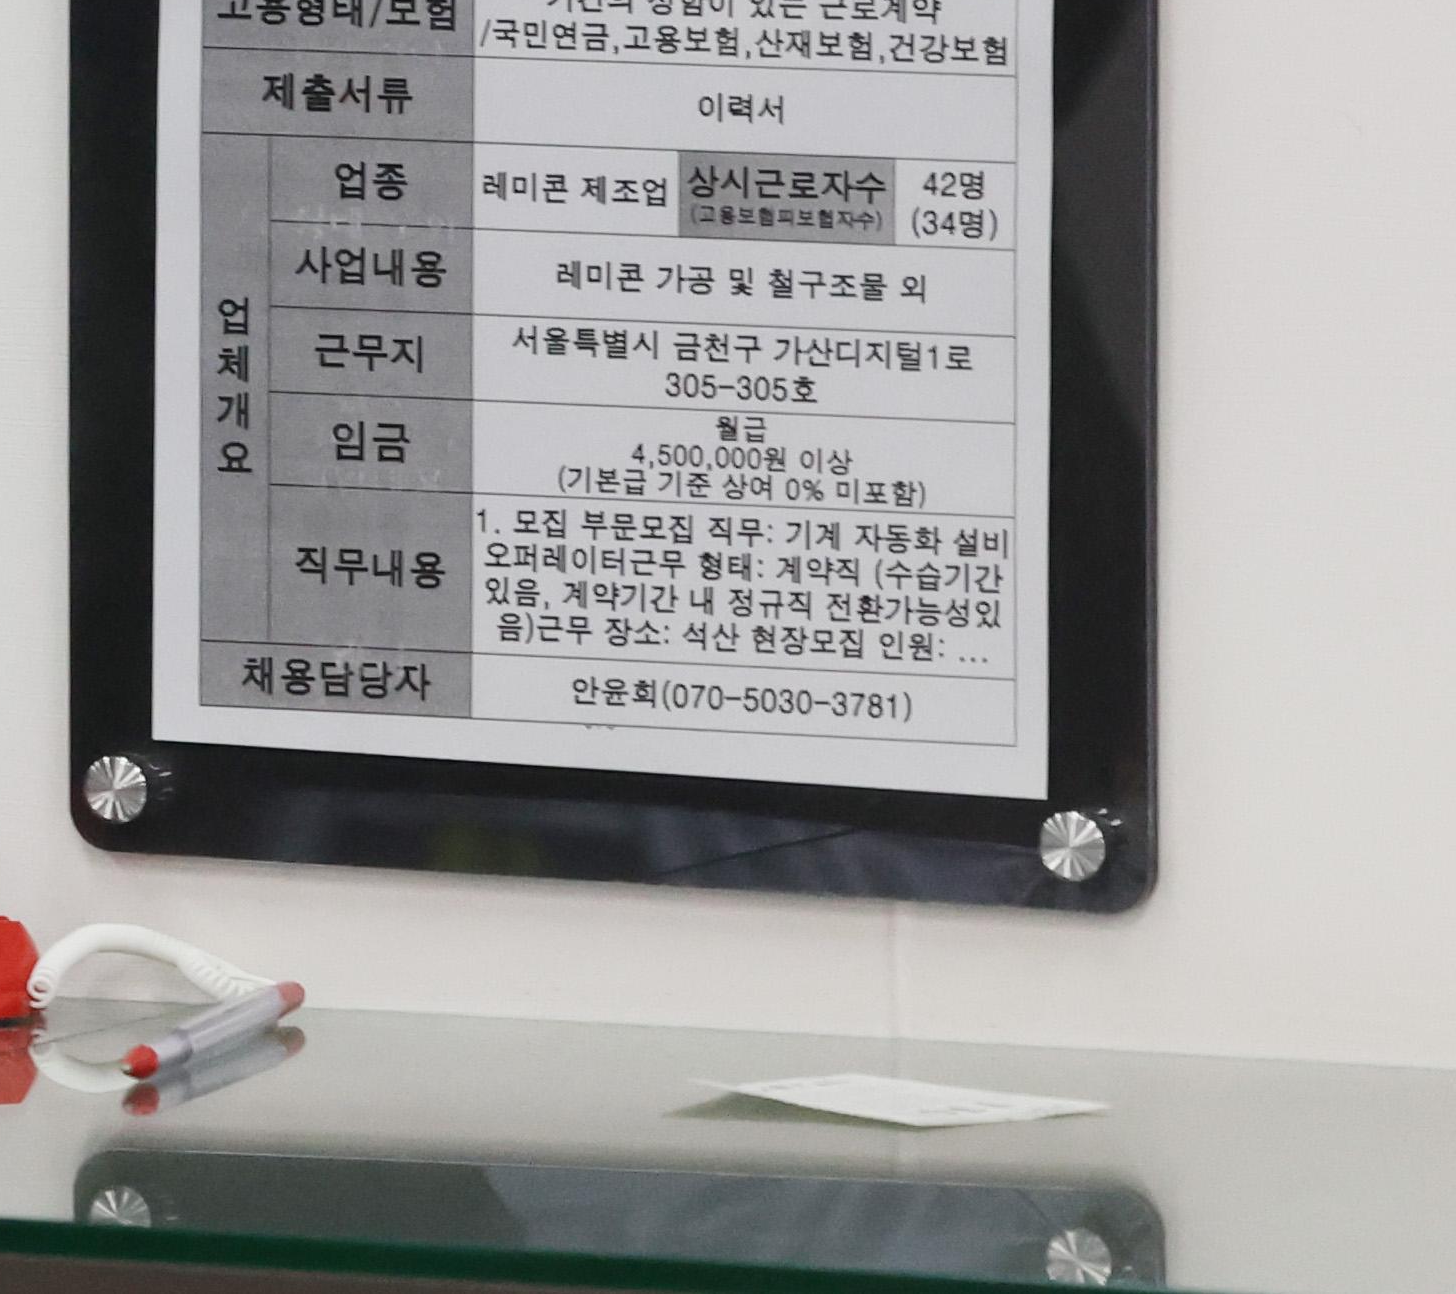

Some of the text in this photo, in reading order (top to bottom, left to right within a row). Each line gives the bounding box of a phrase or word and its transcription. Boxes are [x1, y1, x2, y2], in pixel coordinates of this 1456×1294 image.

[482, 171, 667, 208] 레미콘 제조업
[911, 207, 998, 241] (34명)
[512, 325, 973, 372] 서울특별시 금천구 가산디지털1로
[665, 371, 818, 404] 305-305호
[631, 443, 854, 477] 4,500,000원 이상
[295, 546, 446, 590] 직무내용
